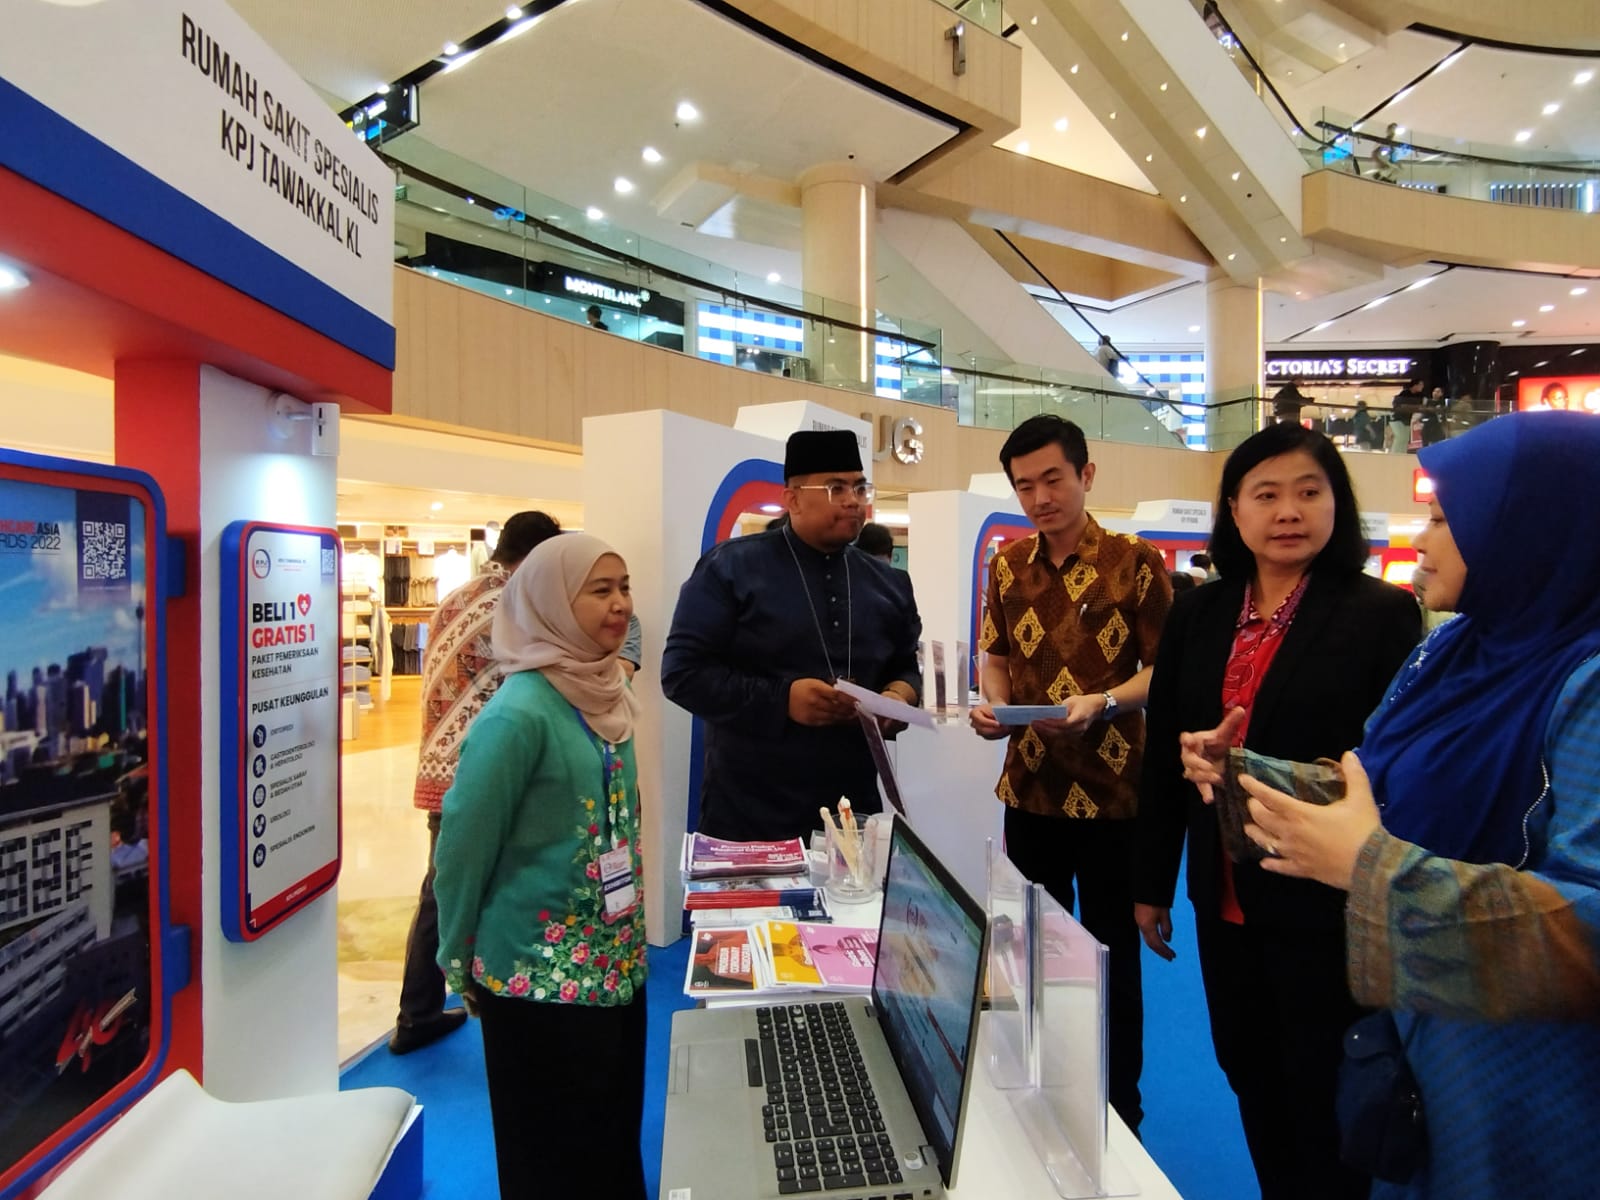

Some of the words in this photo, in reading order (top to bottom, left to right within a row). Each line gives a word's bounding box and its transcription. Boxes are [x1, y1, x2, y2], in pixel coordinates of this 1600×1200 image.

[181, 12, 258, 118] RUMAH
[263, 90, 310, 163] SAKIT
[314, 138, 379, 225] SPESIALIS
[221, 109, 255, 171] KPJ
[260, 142, 342, 243] TAWAKKAL
[346, 216, 362, 259] KL
[1265, 359, 1342, 376] CTORIA'S
[1347, 358, 1410, 375] SECRET
[31, 536, 61, 550] 2022
[252, 602, 286, 623] BELI
[289, 602, 296, 620] 1
[252, 625, 306, 648] GRATIS
[309, 623, 315, 641] 1
[252, 652, 274, 665] PAKET
[275, 647, 319, 662] PEMERIKSAAN
[252, 663, 292, 680] KESEHATAN
[252, 697, 279, 714] PUSAT
[279, 687, 329, 707] KEUNGGULAN
